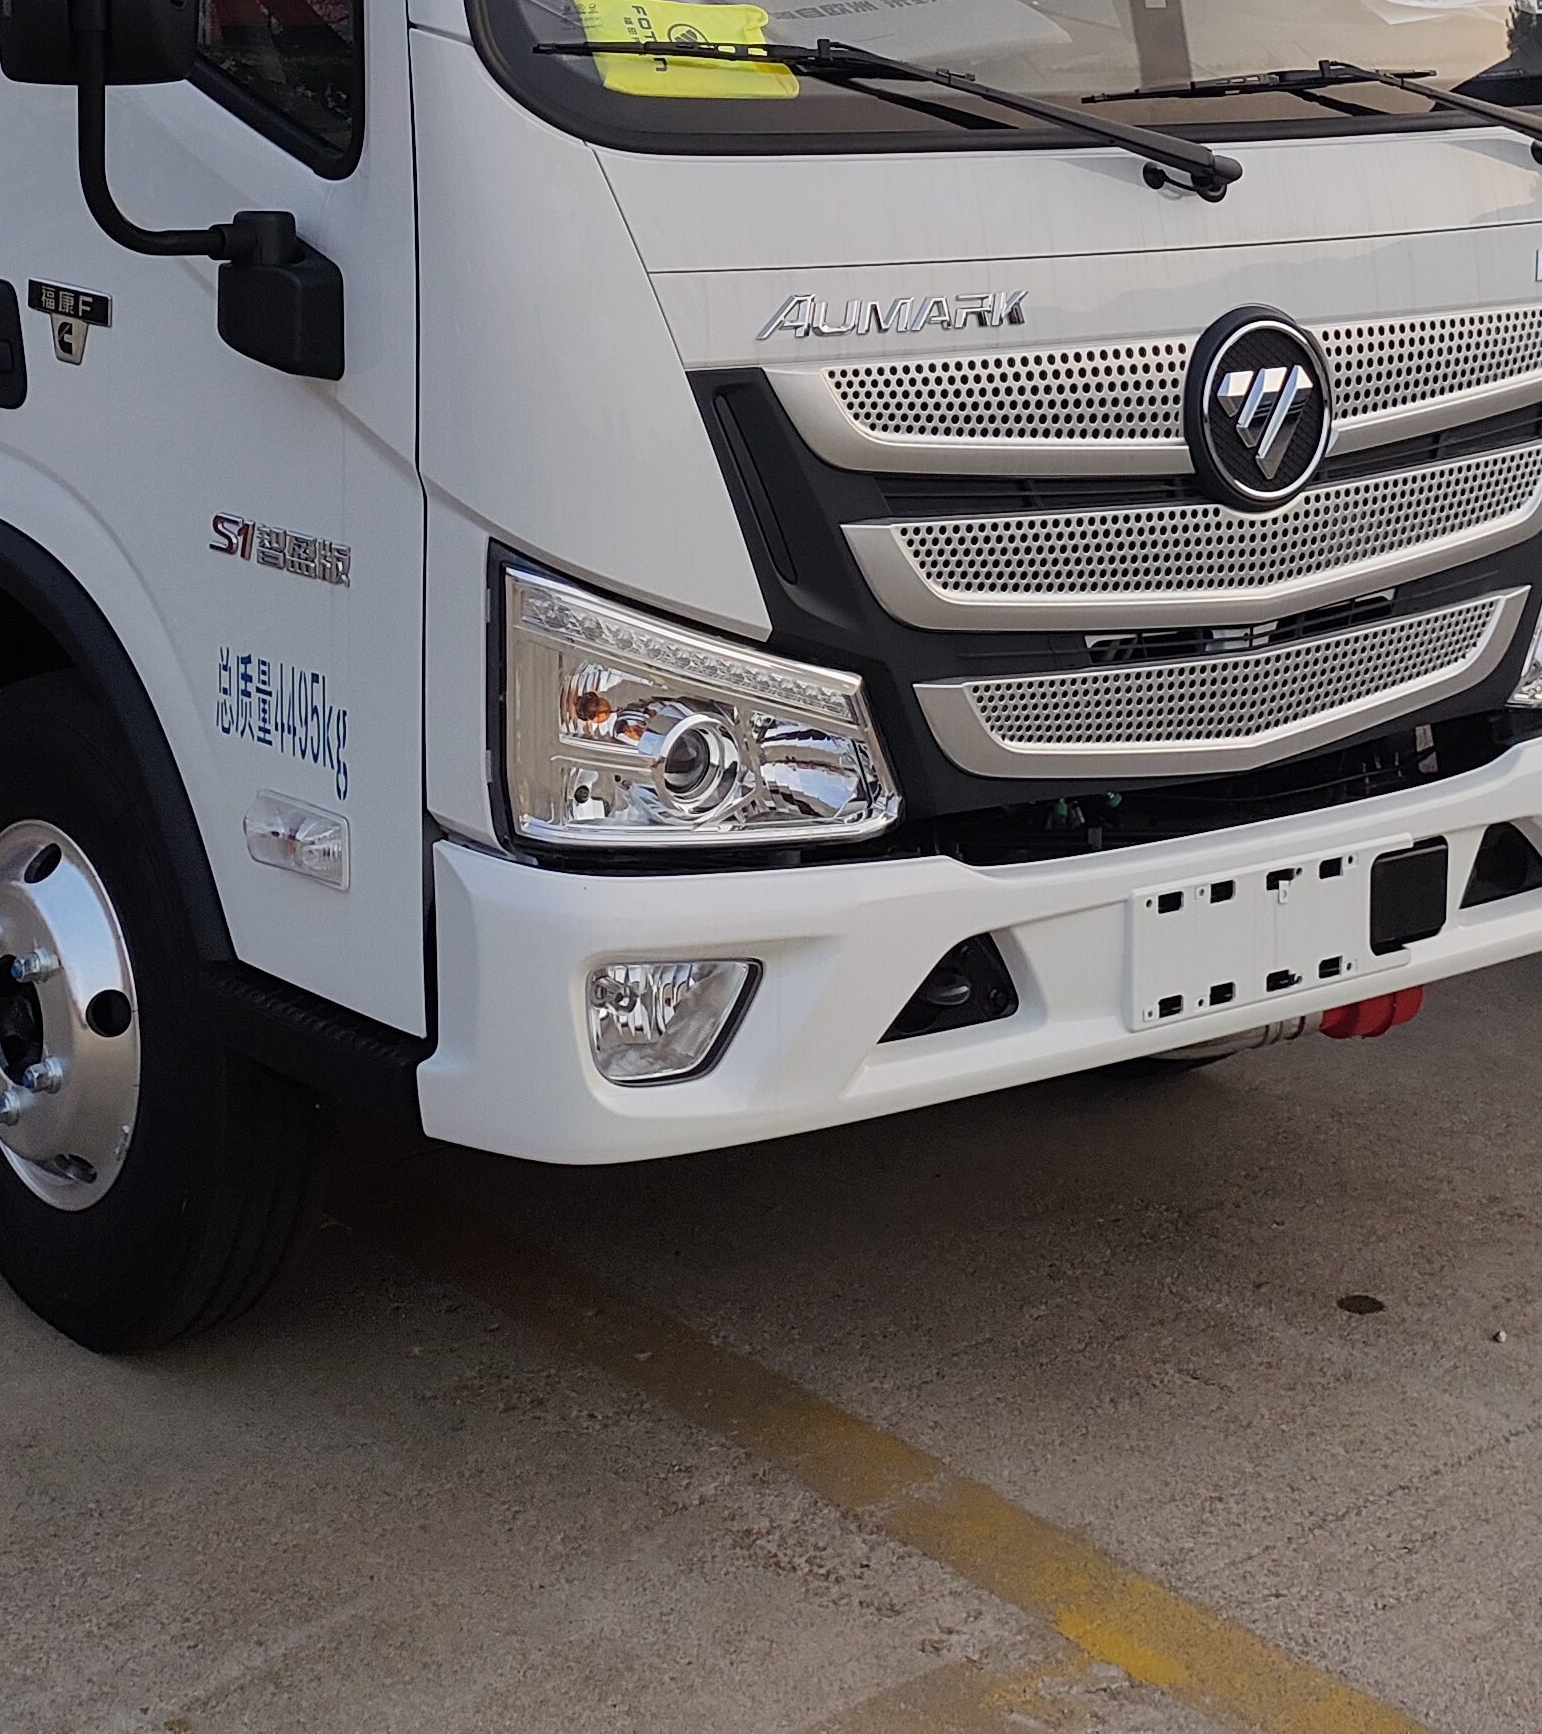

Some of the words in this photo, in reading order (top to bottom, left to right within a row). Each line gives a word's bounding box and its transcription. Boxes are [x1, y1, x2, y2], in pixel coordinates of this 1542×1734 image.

[756, 289, 1030, 341] AUMARK
[216, 645, 349, 802] 总质量4495kg
